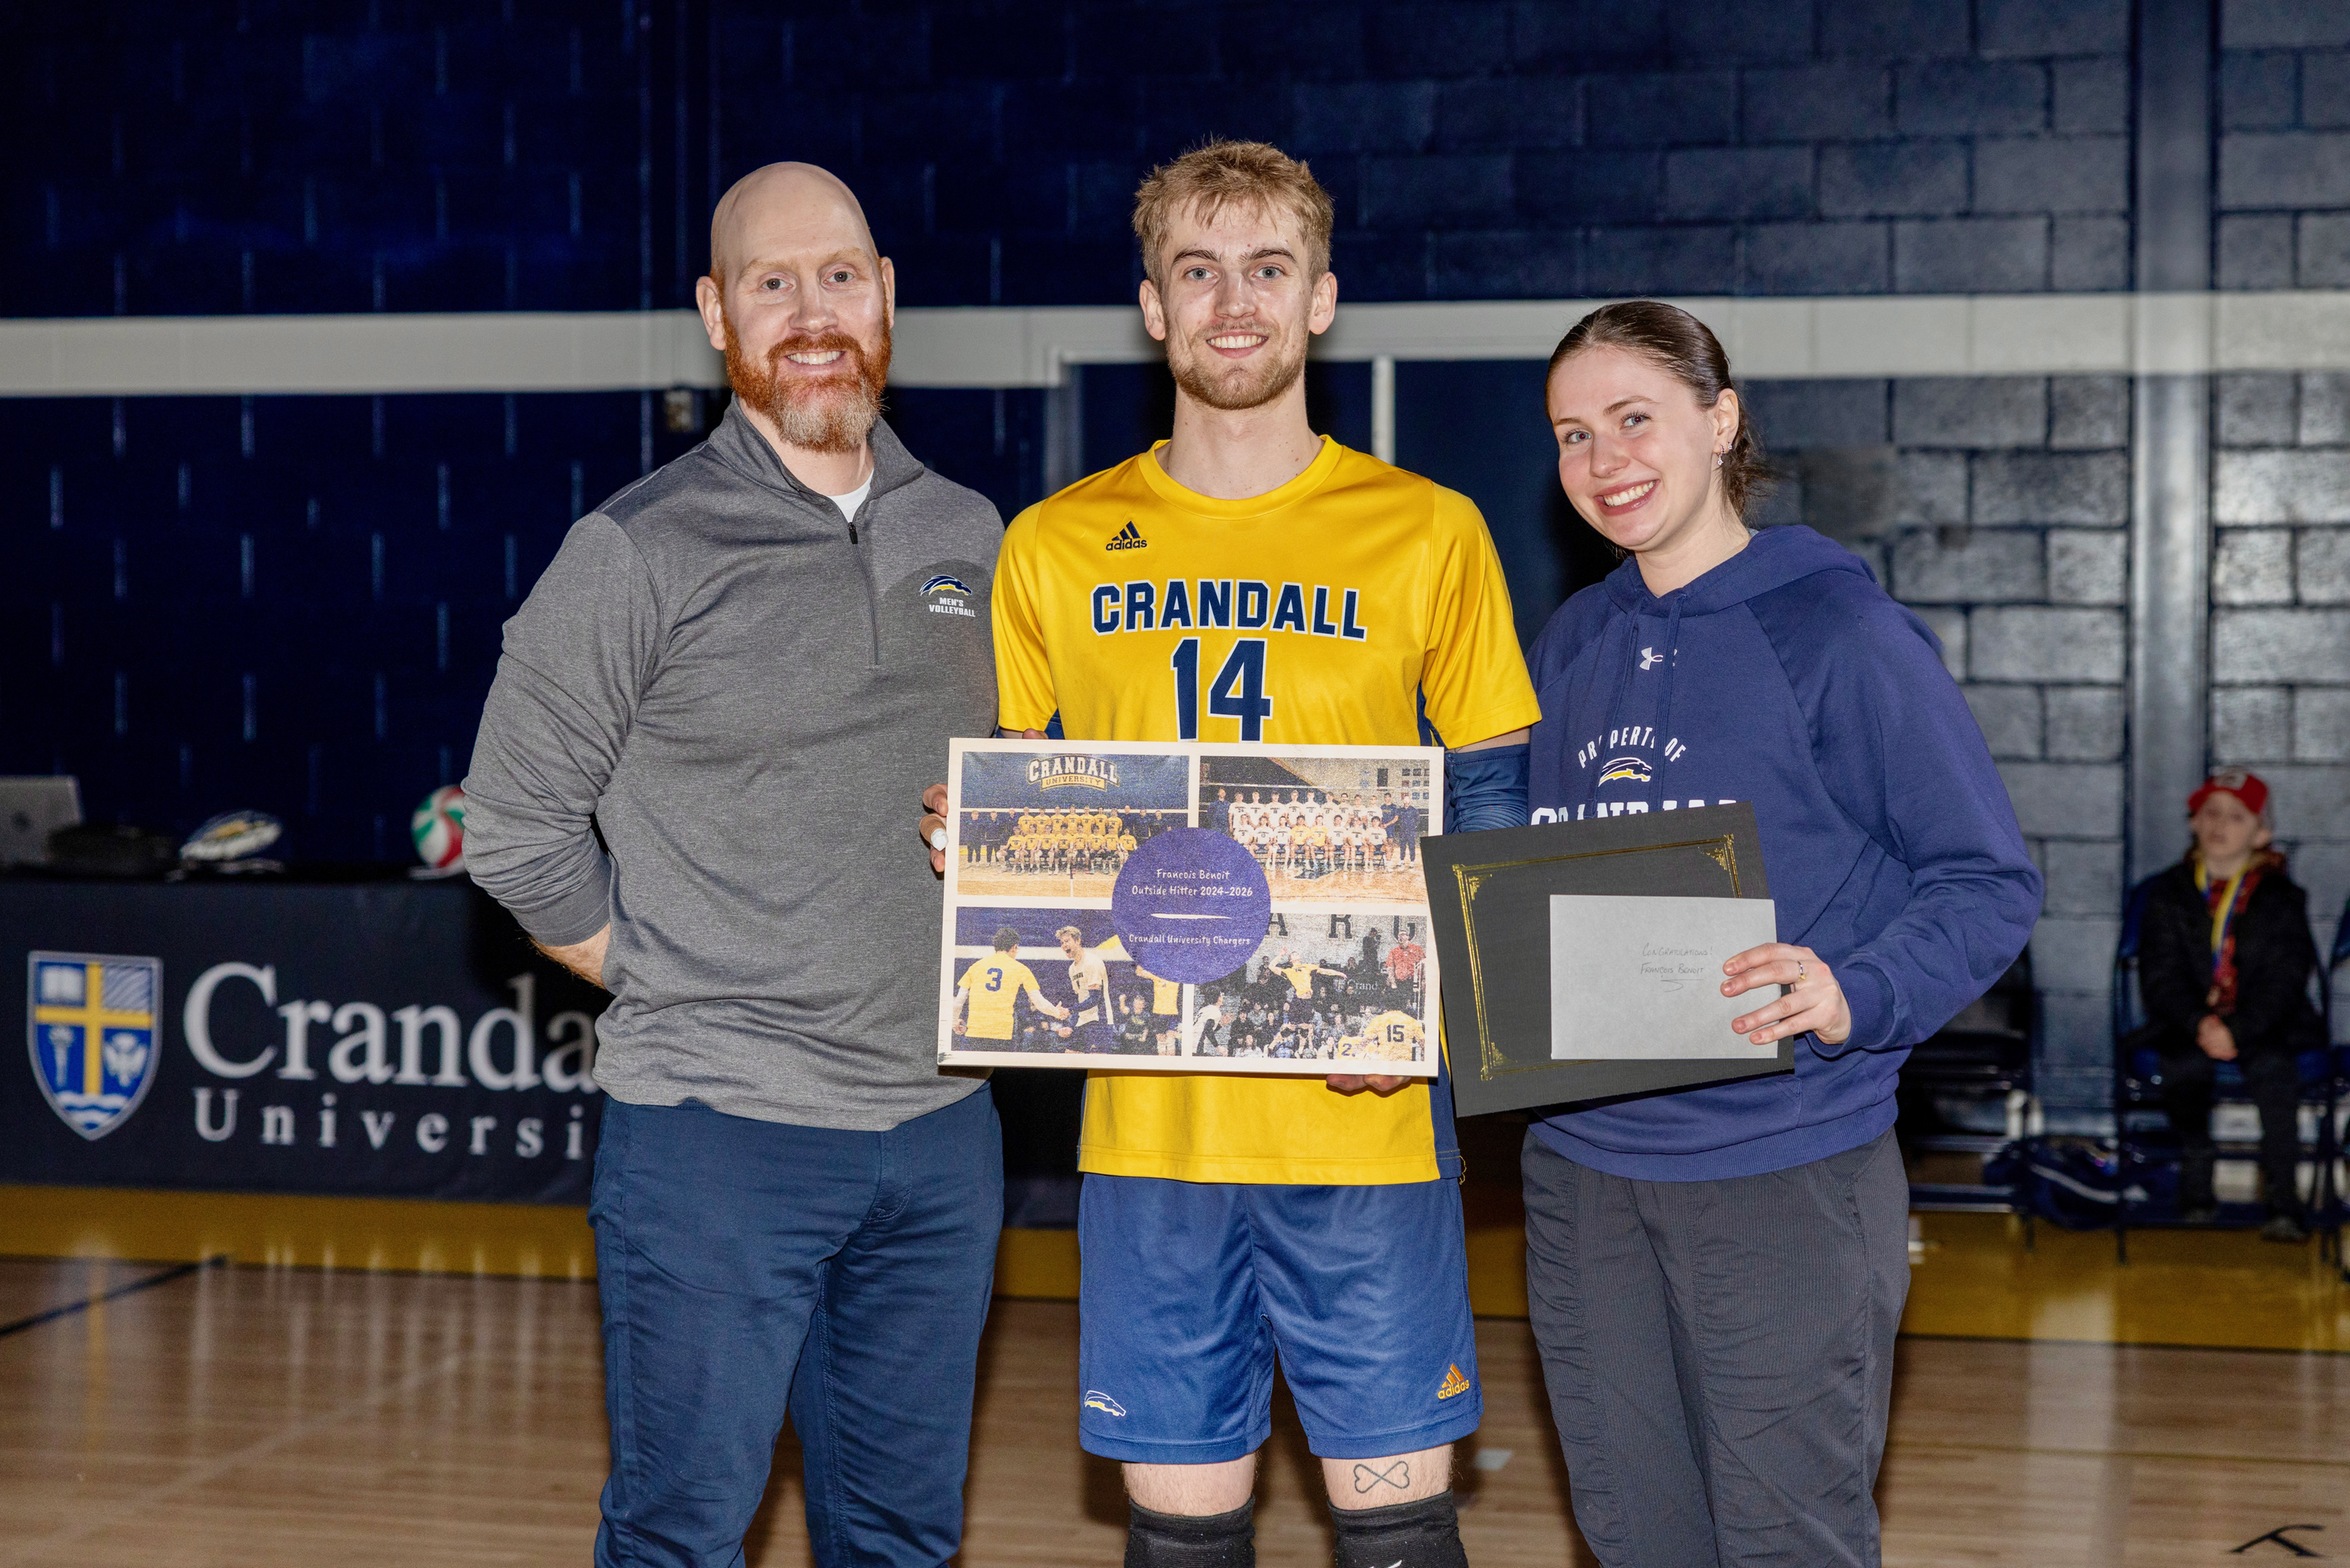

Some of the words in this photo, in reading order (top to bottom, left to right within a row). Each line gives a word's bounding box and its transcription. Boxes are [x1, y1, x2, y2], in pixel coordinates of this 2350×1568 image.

[1105, 536, 1148, 551] adidas
[928, 604, 976, 618] VOLLEYBALL
[939, 597, 964, 607] MEN'S
[1090, 578, 1368, 643] CRANDALL
[1170, 636, 1274, 743] 14
[1578, 726, 1656, 769] PRPERT
[1664, 737, 1687, 762] OF
[1027, 755, 1120, 786] CRANDALL
[1045, 775, 1101, 786] UNIVERSITY
[1156, 868, 1197, 880] Francois
[1199, 869, 1230, 880] Benoit
[1131, 885, 1167, 896] Outside
[1169, 885, 1198, 896] Hitter
[1200, 886, 1253, 897] 2024-2026
[1128, 934, 1166, 944] Crandall
[1167, 935, 1211, 945] University
[1213, 935, 1251, 947] Chargers
[985, 967, 1003, 992] 3
[1386, 1024, 1404, 1043] 15
[193, 1087, 584, 1160] Universi
[1437, 1379, 1470, 1400] adidas
